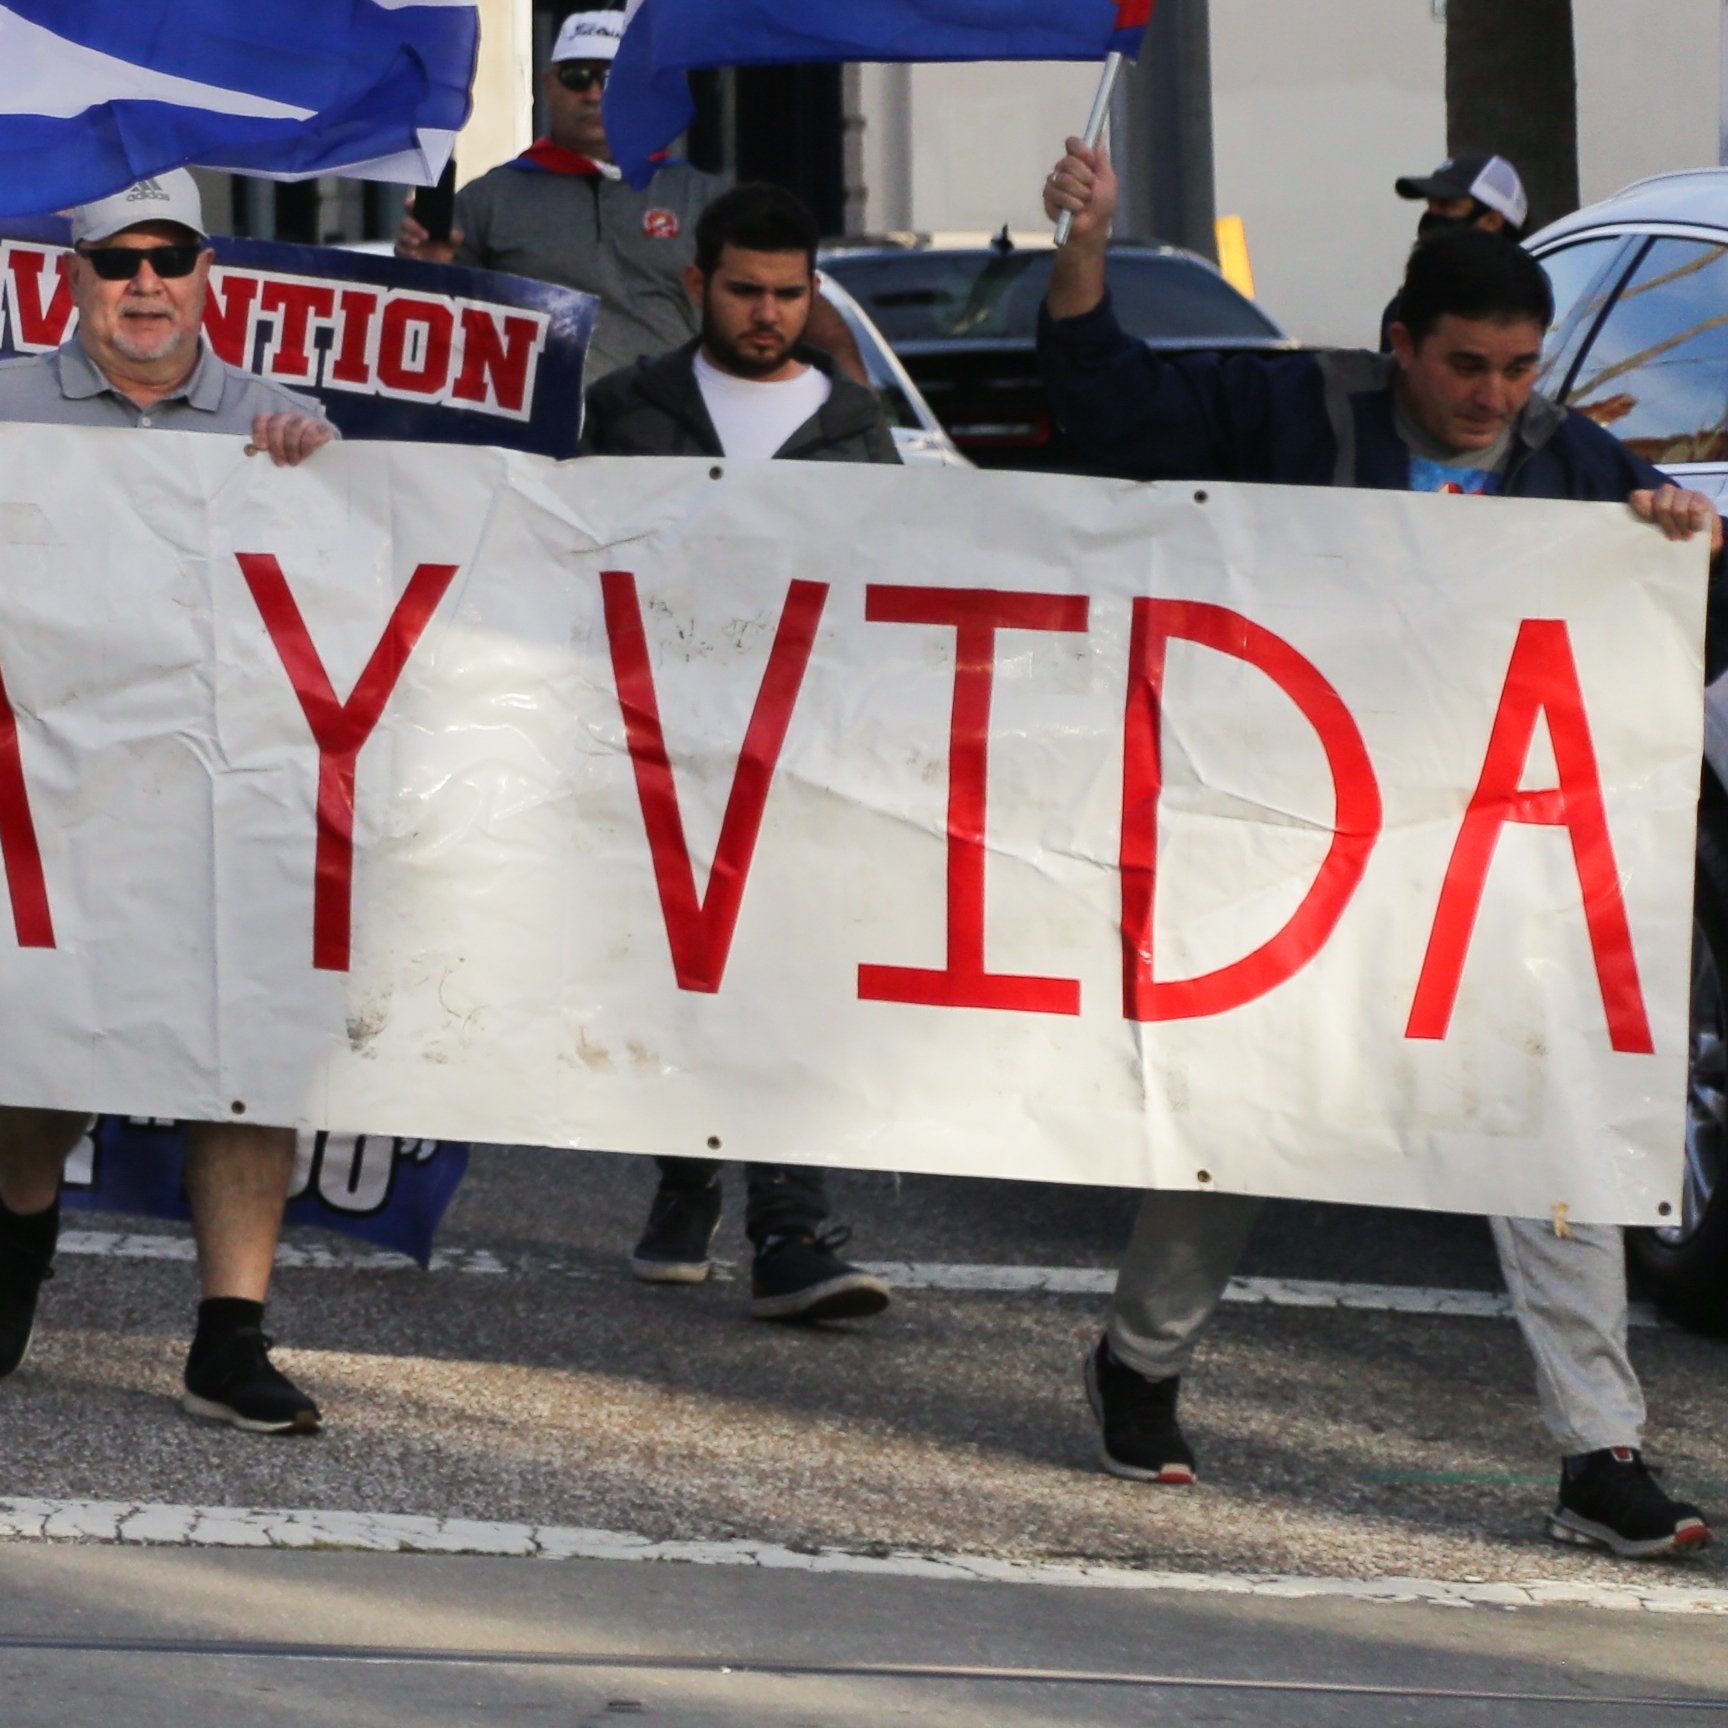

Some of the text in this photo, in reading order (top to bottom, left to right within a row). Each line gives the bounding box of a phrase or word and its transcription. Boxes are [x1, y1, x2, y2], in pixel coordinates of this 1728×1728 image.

[126, 191, 170, 202] adidas
[234, 552, 458, 973] Y
[600, 568, 1655, 1055] VIDA
